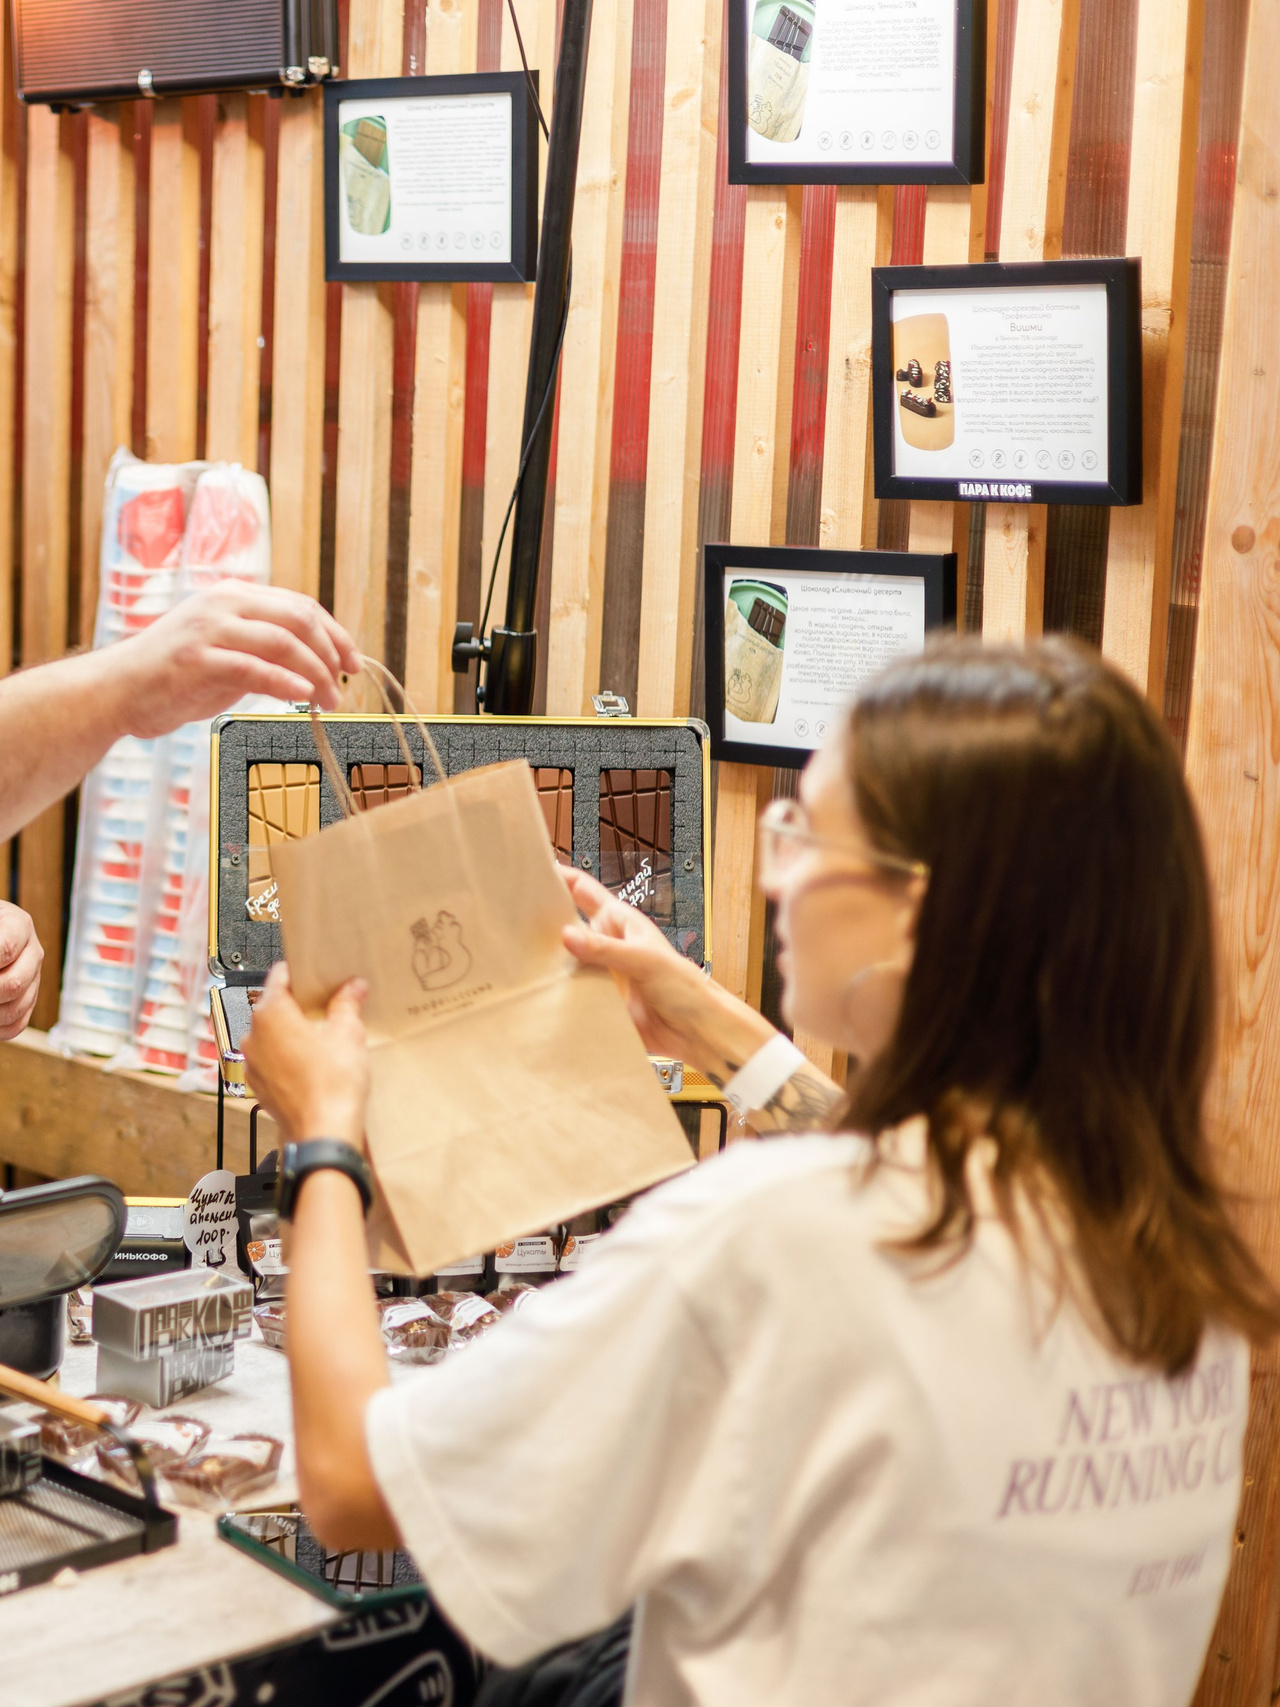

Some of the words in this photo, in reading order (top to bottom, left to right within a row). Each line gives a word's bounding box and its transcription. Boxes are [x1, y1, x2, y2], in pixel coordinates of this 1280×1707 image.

[1010, 322, 1043, 332] Вишми
[959, 483, 989, 496] ПАРА
[990, 484, 999, 496] К
[999, 484, 1032, 497] КОФЕ
[801, 585, 830, 594] Шоколад
[190, 1188, 236, 1213] Цукаты
[114, 1252, 168, 1261] ИНЬКОФФ
[516, 1248, 547, 1257] Цукаты
[1057, 1379, 1156, 1447] NEW
[995, 1433, 1207, 1520] RUNNING
